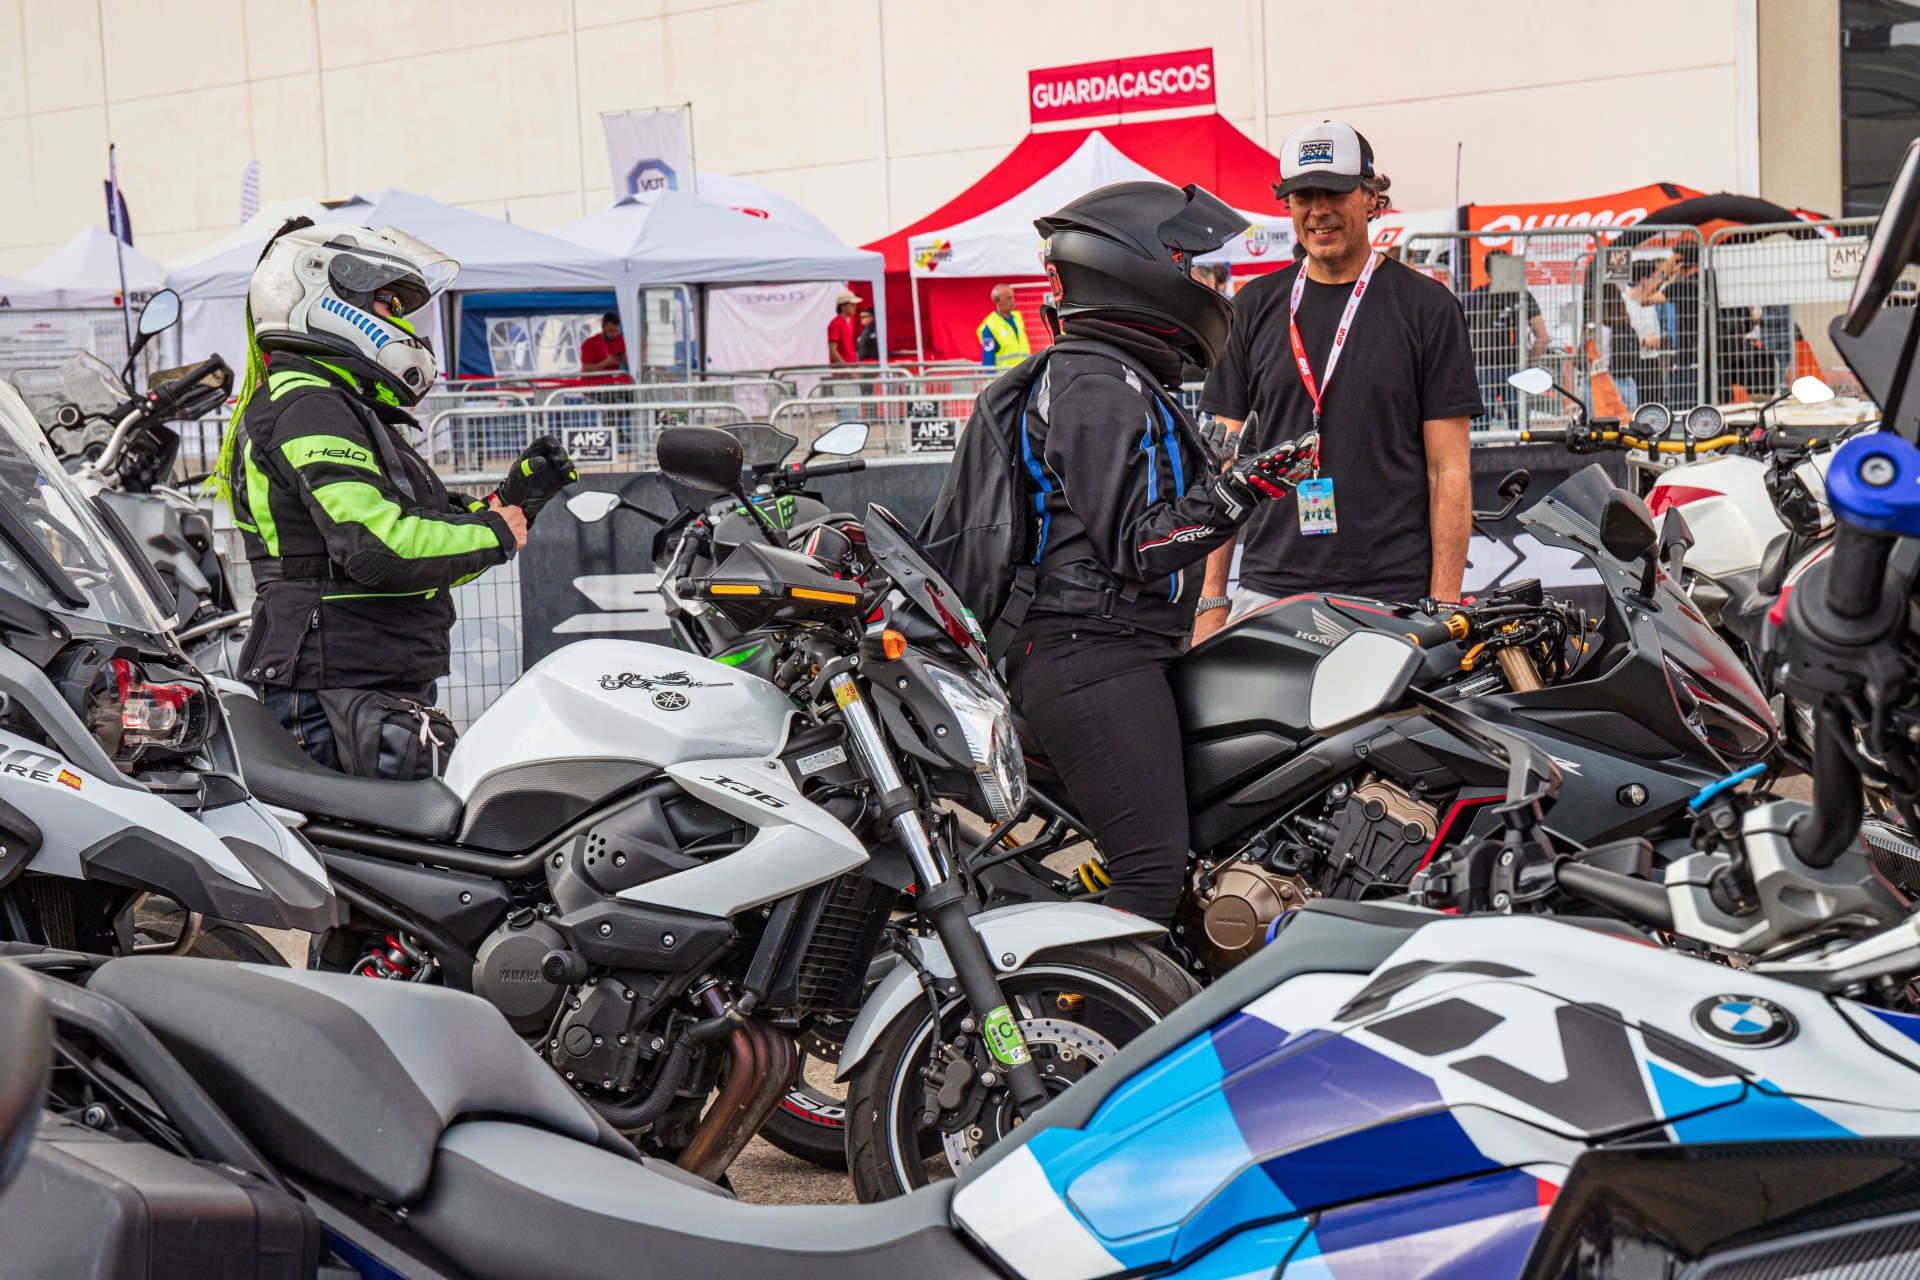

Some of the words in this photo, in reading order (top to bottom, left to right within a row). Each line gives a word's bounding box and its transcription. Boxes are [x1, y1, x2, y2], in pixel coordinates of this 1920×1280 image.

[1032, 63, 1211, 109] GUARDACASCOS
[1355, 280, 1366, 298] GIVI
[1336, 328, 1347, 347] GIVI
[917, 421, 950, 438] AMS
[573, 431, 606, 447] AMS
[1294, 630, 1338, 648] HON
[0, 761, 54, 783] RE
[699, 774, 791, 809] XJ6
[500, 969, 542, 983] YAMAHA
